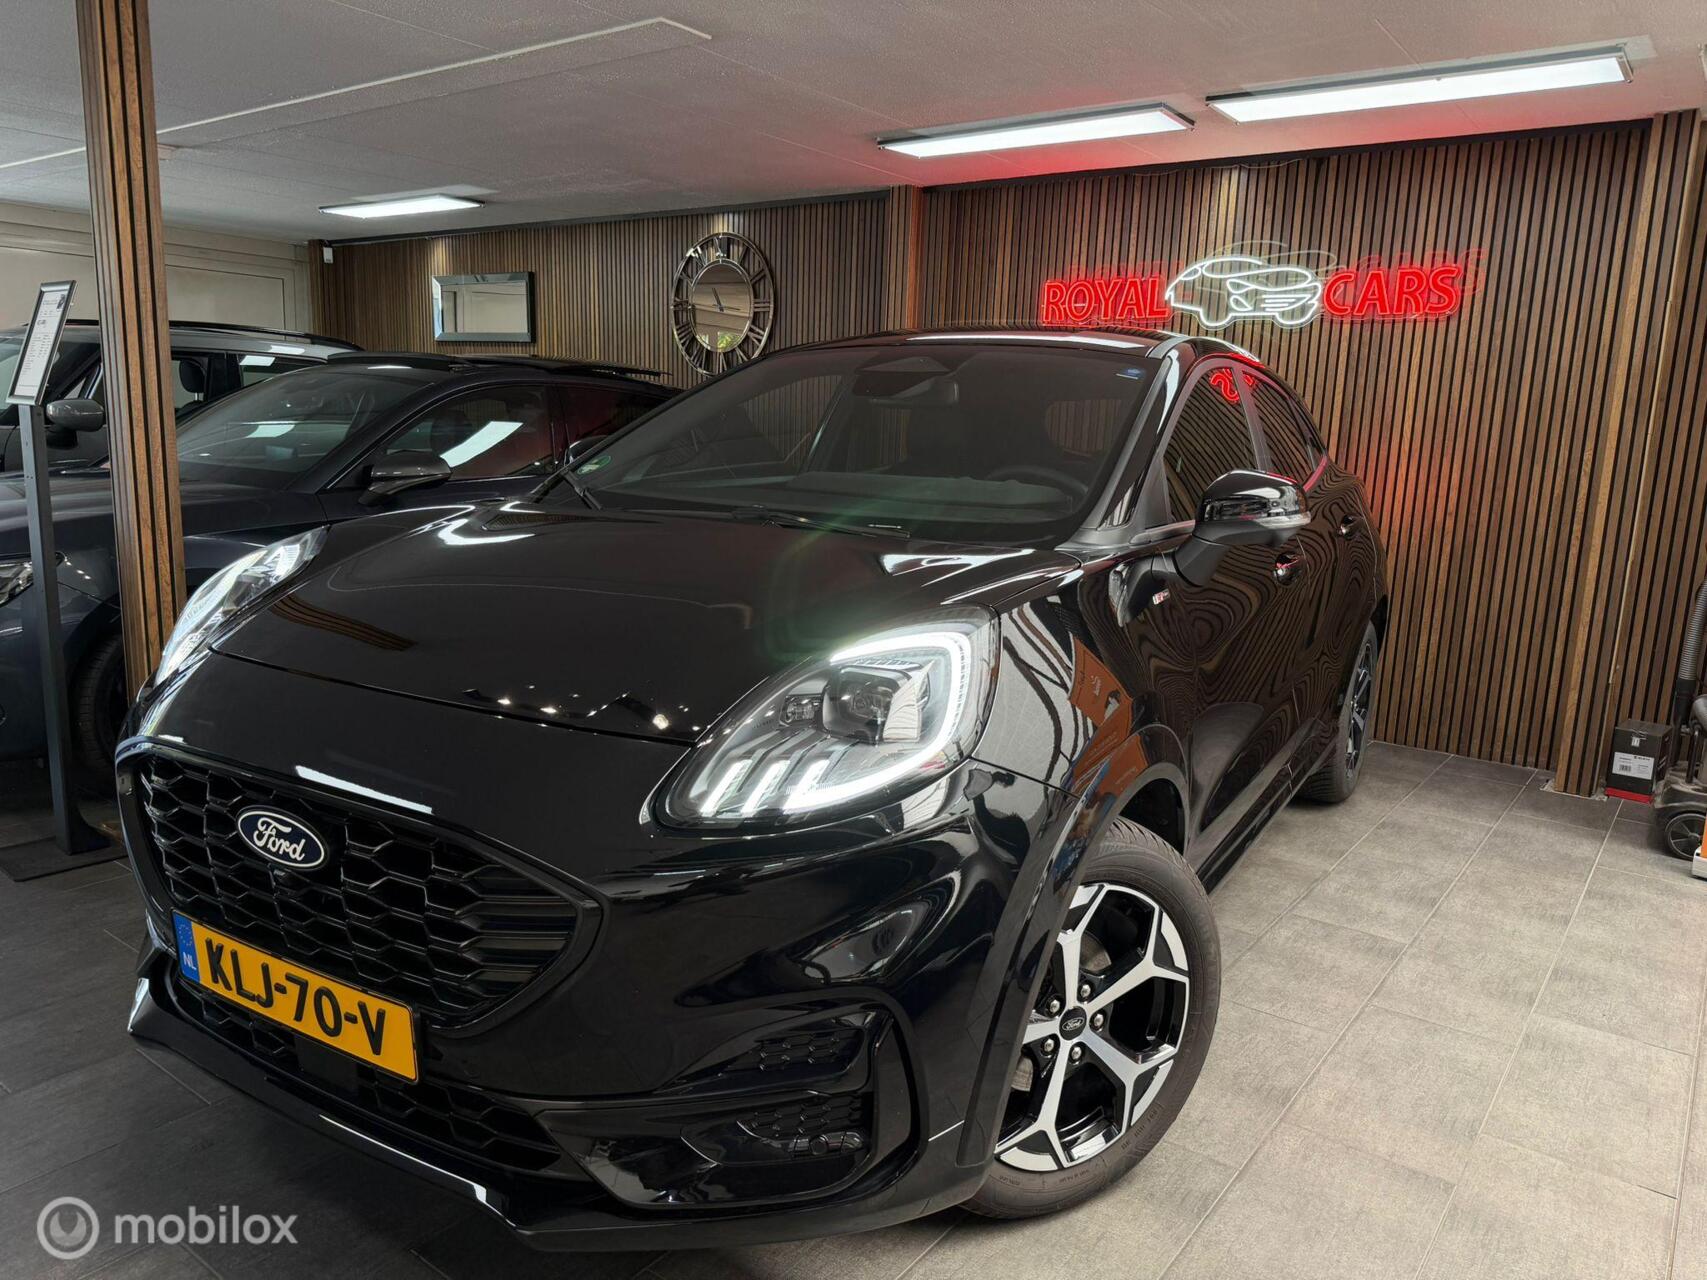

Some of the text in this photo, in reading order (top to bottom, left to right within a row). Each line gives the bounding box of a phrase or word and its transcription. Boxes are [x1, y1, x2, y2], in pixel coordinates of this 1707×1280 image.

[1042, 266, 1460, 322] ROYAL CARS
[253, 816, 306, 861] Ford
[183, 952, 197, 971] NL
[205, 937, 386, 1056] KLJ-70-V
